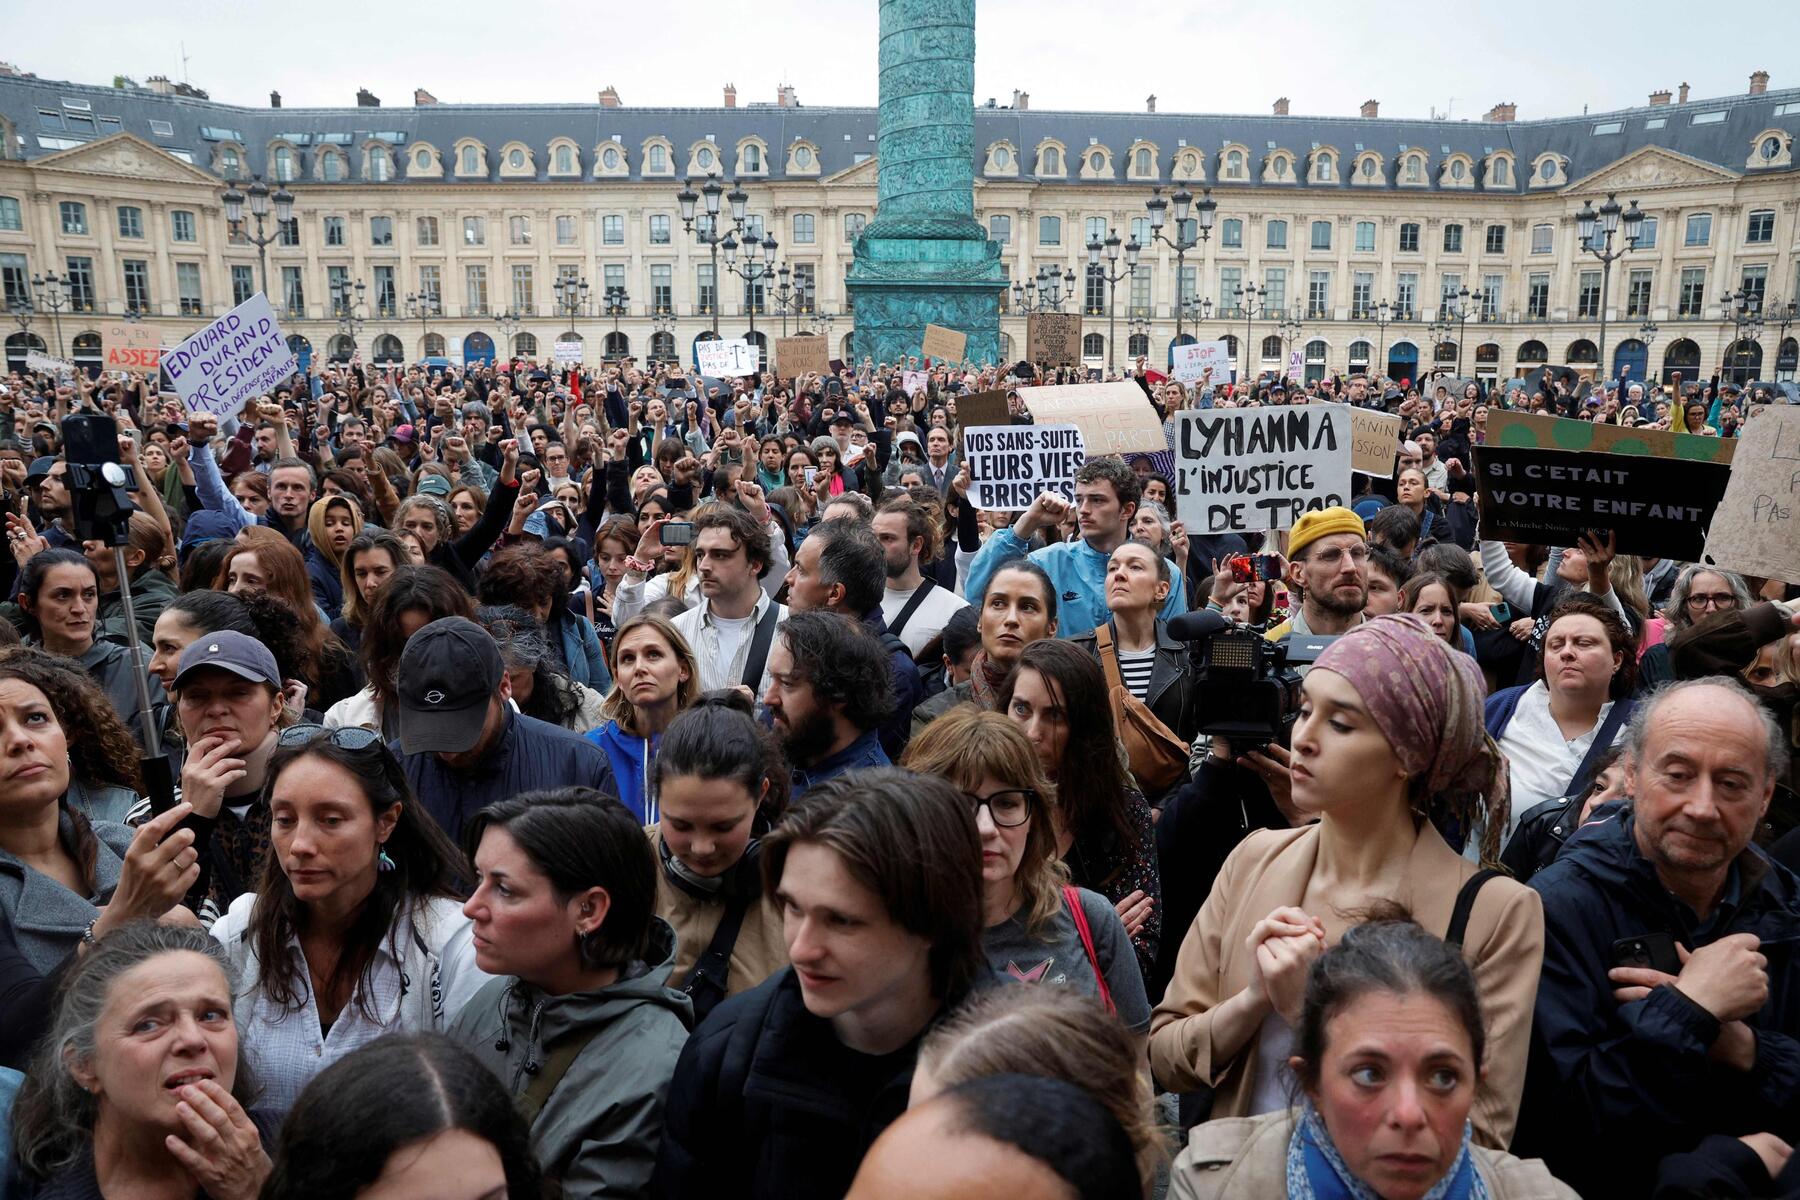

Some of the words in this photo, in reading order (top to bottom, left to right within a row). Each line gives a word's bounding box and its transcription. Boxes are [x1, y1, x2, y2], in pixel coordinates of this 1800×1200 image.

[109, 348, 160, 367] ASSEZ
[166, 315, 240, 379] EDOUARD
[200, 318, 270, 376] DURAND
[698, 343, 710, 353] PAS
[715, 342, 725, 351] DE
[1187, 347, 1216, 359] STOP
[1290, 352, 1303, 365] ON
[260, 358, 295, 392] ENFANTS
[703, 361, 717, 370] PAS
[966, 433, 993, 453] VOS
[997, 430, 1083, 451] SANS-SUITE.
[1104, 429, 1158, 450] PART
[1180, 410, 1338, 460] LYHANNA
[969, 453, 1033, 482] LEURS
[1039, 451, 1084, 479] VIES
[1178, 460, 1315, 495] L'INJUSTICE
[1489, 462, 1512, 478] SI
[1525, 466, 1629, 486] C'ETAIT
[1208, 503, 1246, 532] DE
[1492, 490, 1581, 512] VOTRE
[1594, 500, 1702, 523] ENFANT
[1496, 519, 1507, 528] La
[1509, 520, 1543, 530] Marche
[1545, 523, 1570, 533] Noire
